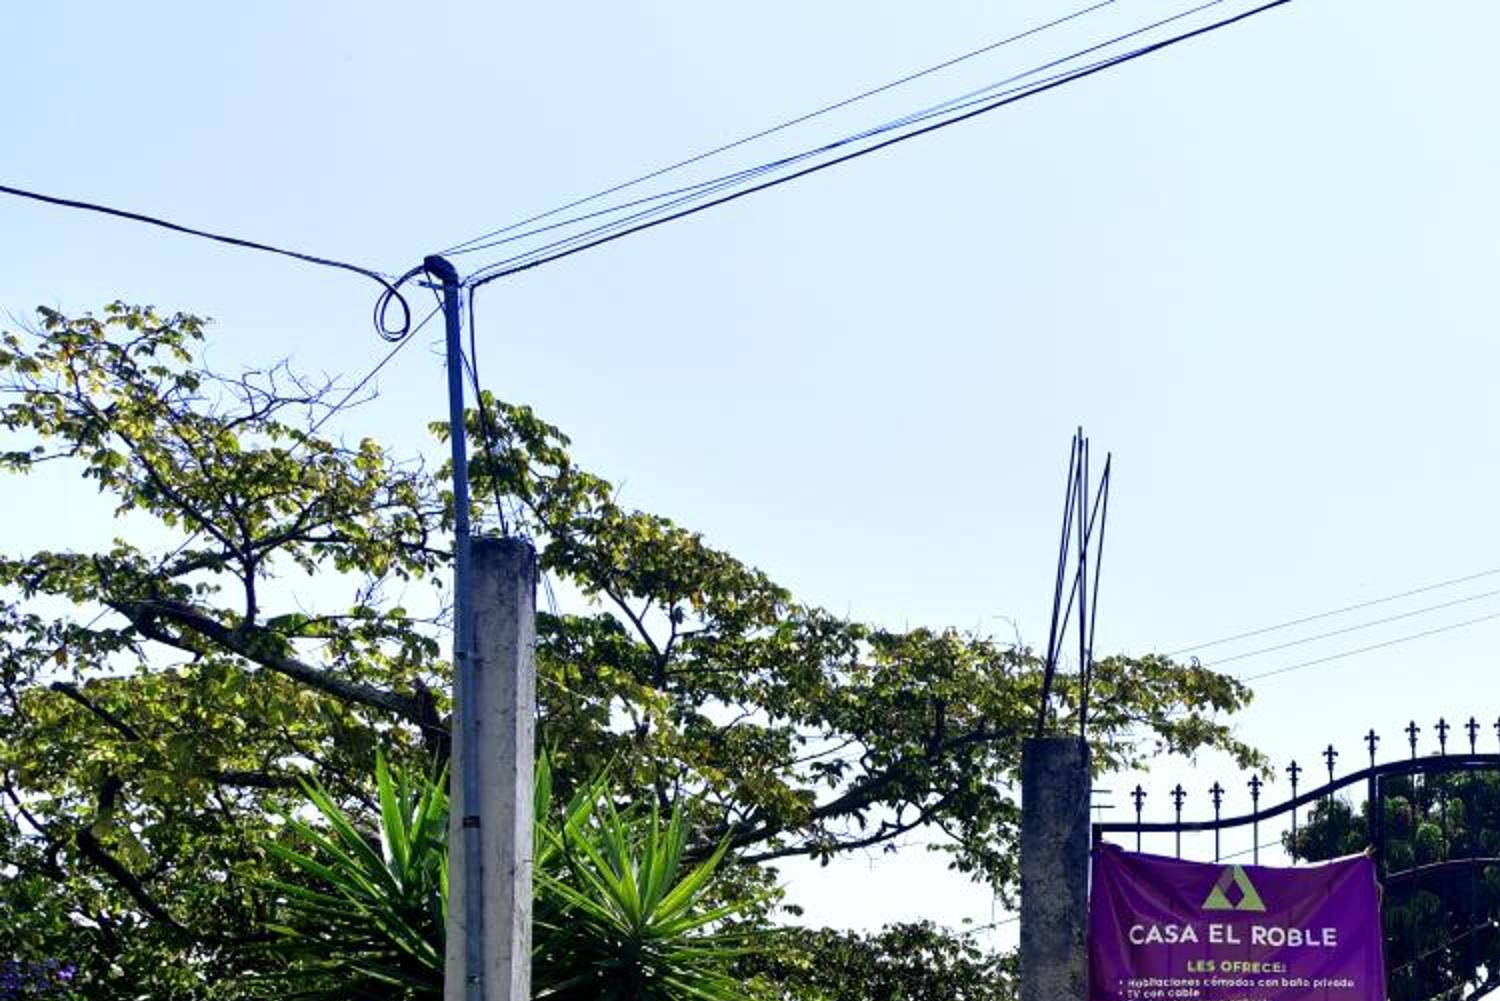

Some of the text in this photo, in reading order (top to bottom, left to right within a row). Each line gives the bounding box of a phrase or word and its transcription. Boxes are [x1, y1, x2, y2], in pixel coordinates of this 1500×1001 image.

[1129, 923, 1338, 947] CASA EL ROBLE
[1187, 960, 1287, 974] LES OFRECE:
[1127, 976, 1354, 989] Habitaciones cómodas con baño privado
[1127, 988, 1200, 998] TV con cable
